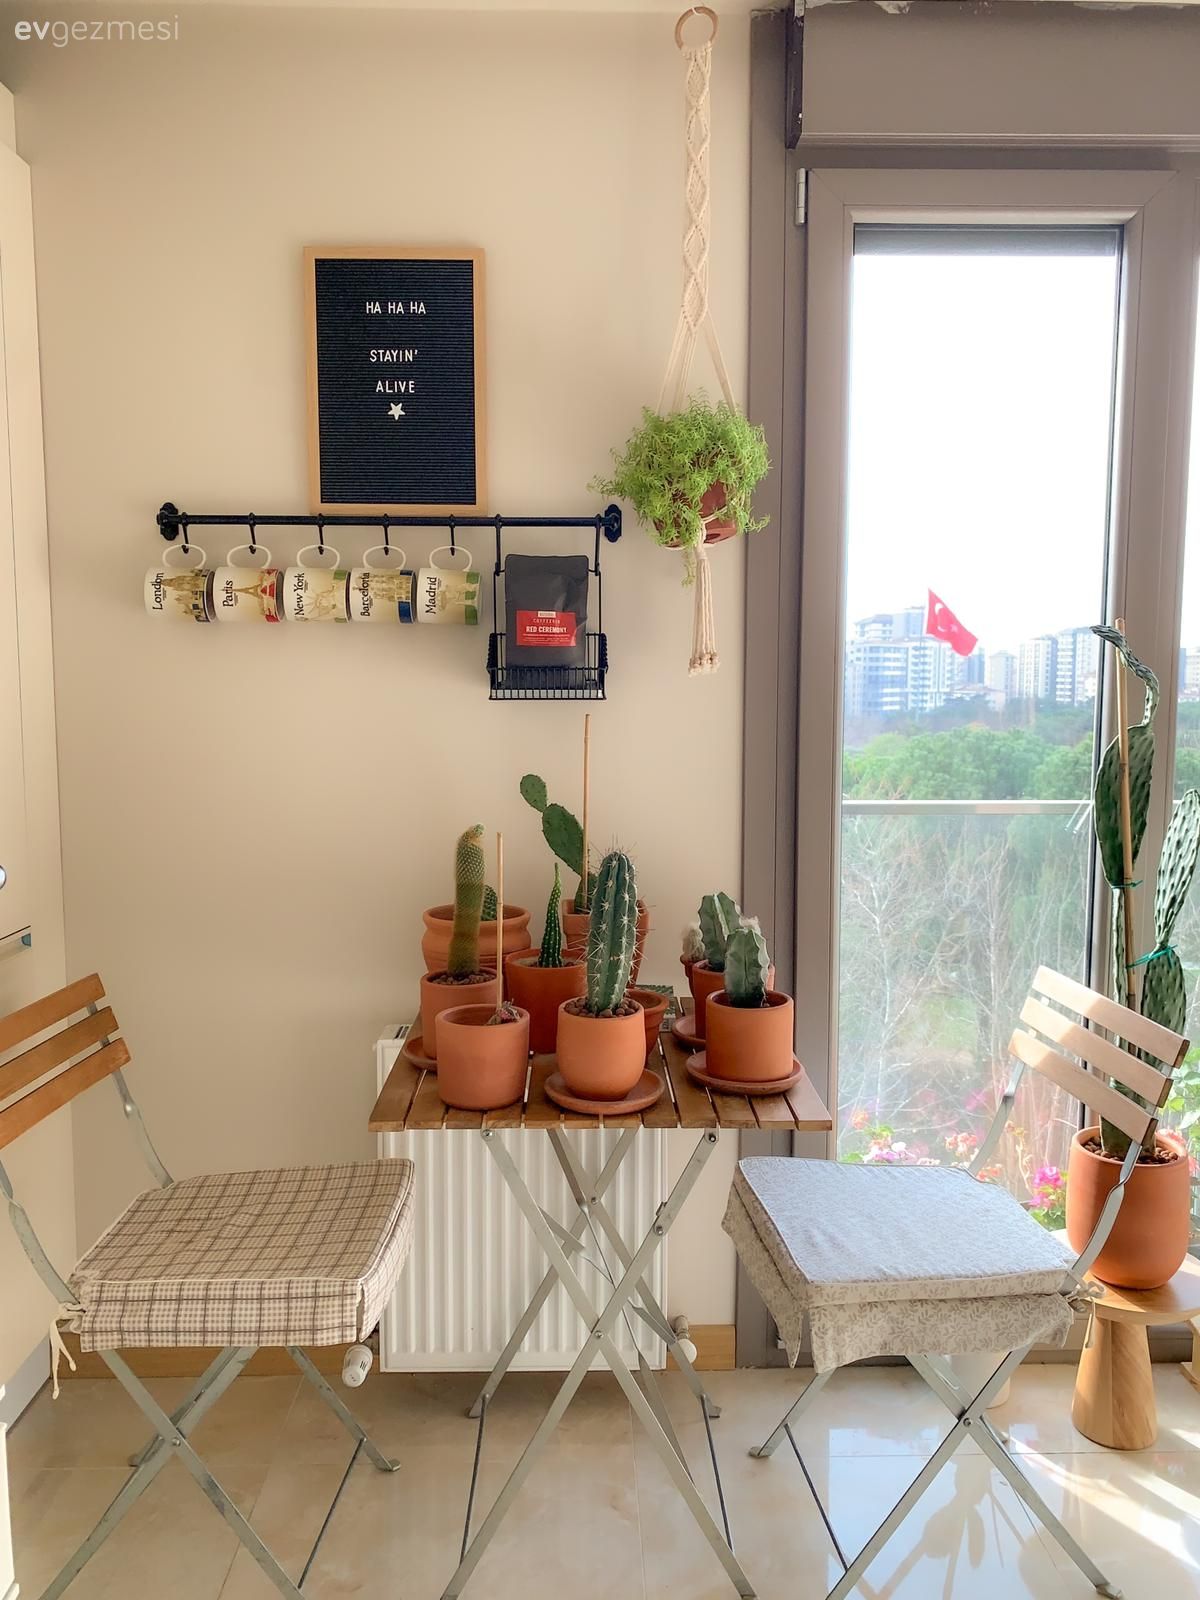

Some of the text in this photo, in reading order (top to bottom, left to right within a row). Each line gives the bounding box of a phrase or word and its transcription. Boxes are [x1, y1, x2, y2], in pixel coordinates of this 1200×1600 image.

[366, 301, 426, 314] HA HA HA
[369, 349, 418, 362] STAYIN'
[375, 380, 415, 393] ALIVE
[151, 572, 164, 610] London
[222, 580, 234, 607] Paris
[293, 572, 305, 616] New York
[359, 572, 371, 616] Barcelona
[425, 577, 437, 614] Madrid
